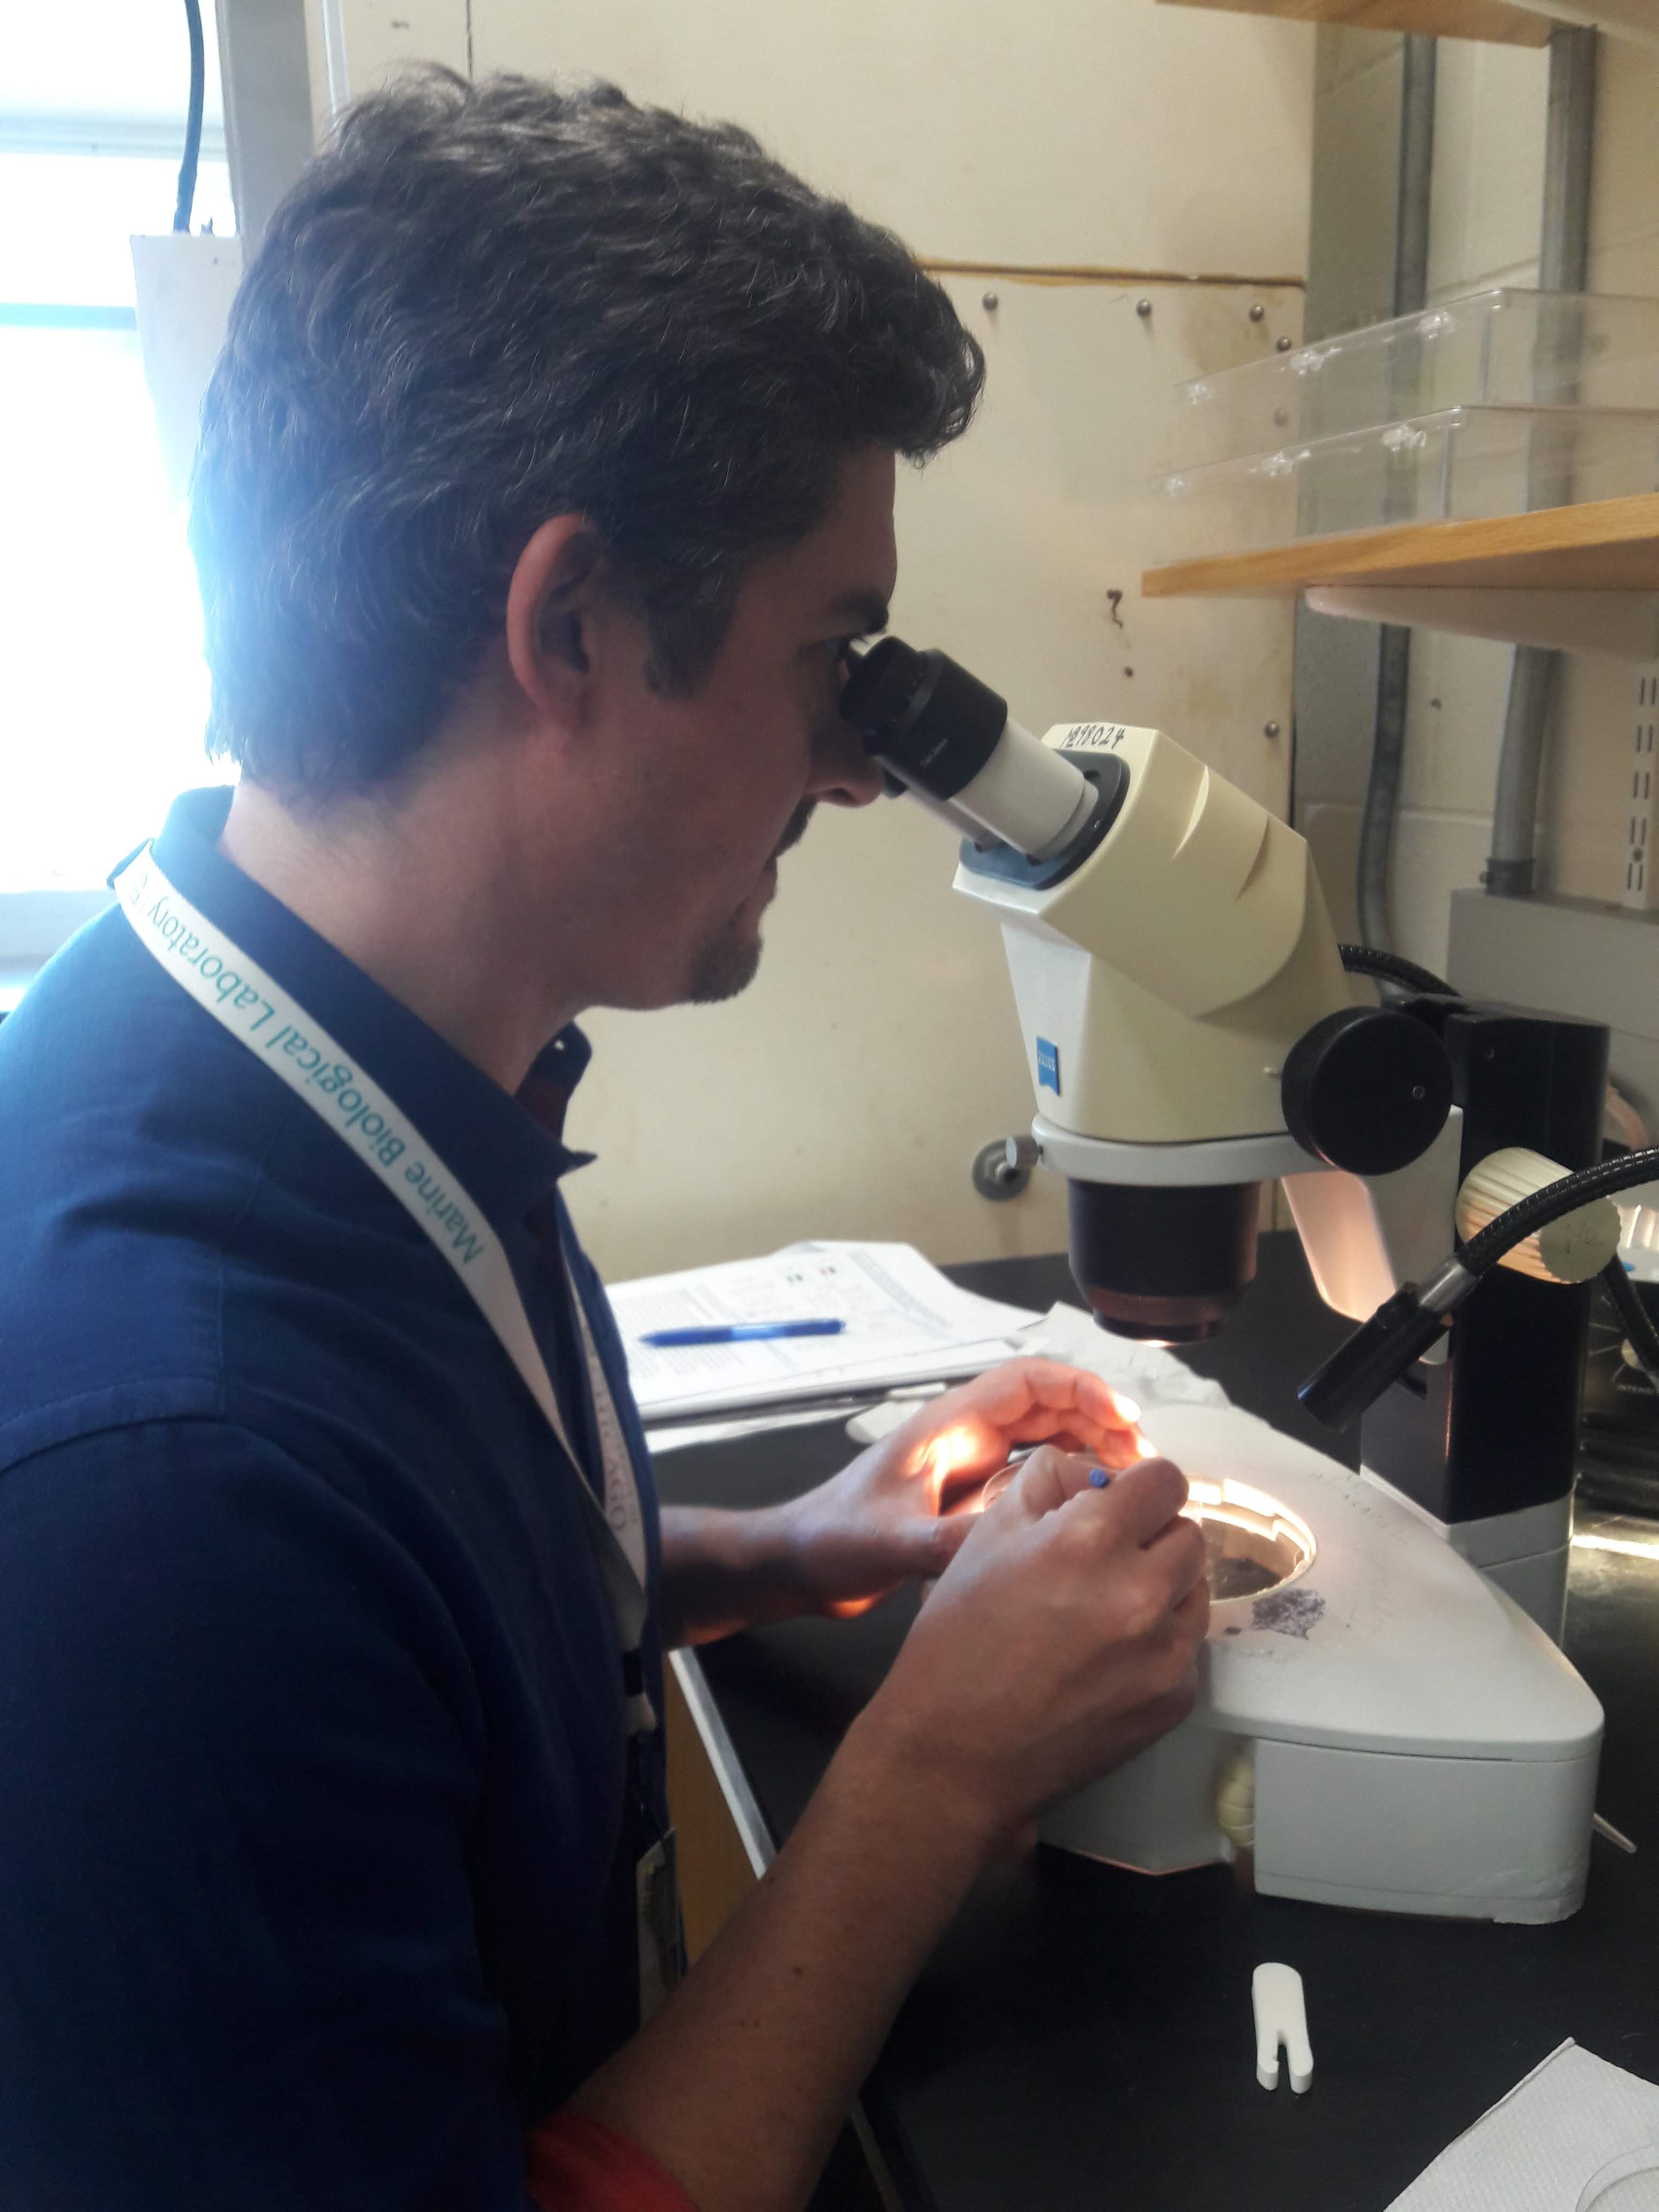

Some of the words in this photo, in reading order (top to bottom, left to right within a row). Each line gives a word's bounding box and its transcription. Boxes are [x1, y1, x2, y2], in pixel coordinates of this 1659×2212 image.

[146, 896, 274, 1032] Laboratory
[265, 1026, 406, 1167] Biological
[404, 1163, 484, 1264] Marine
